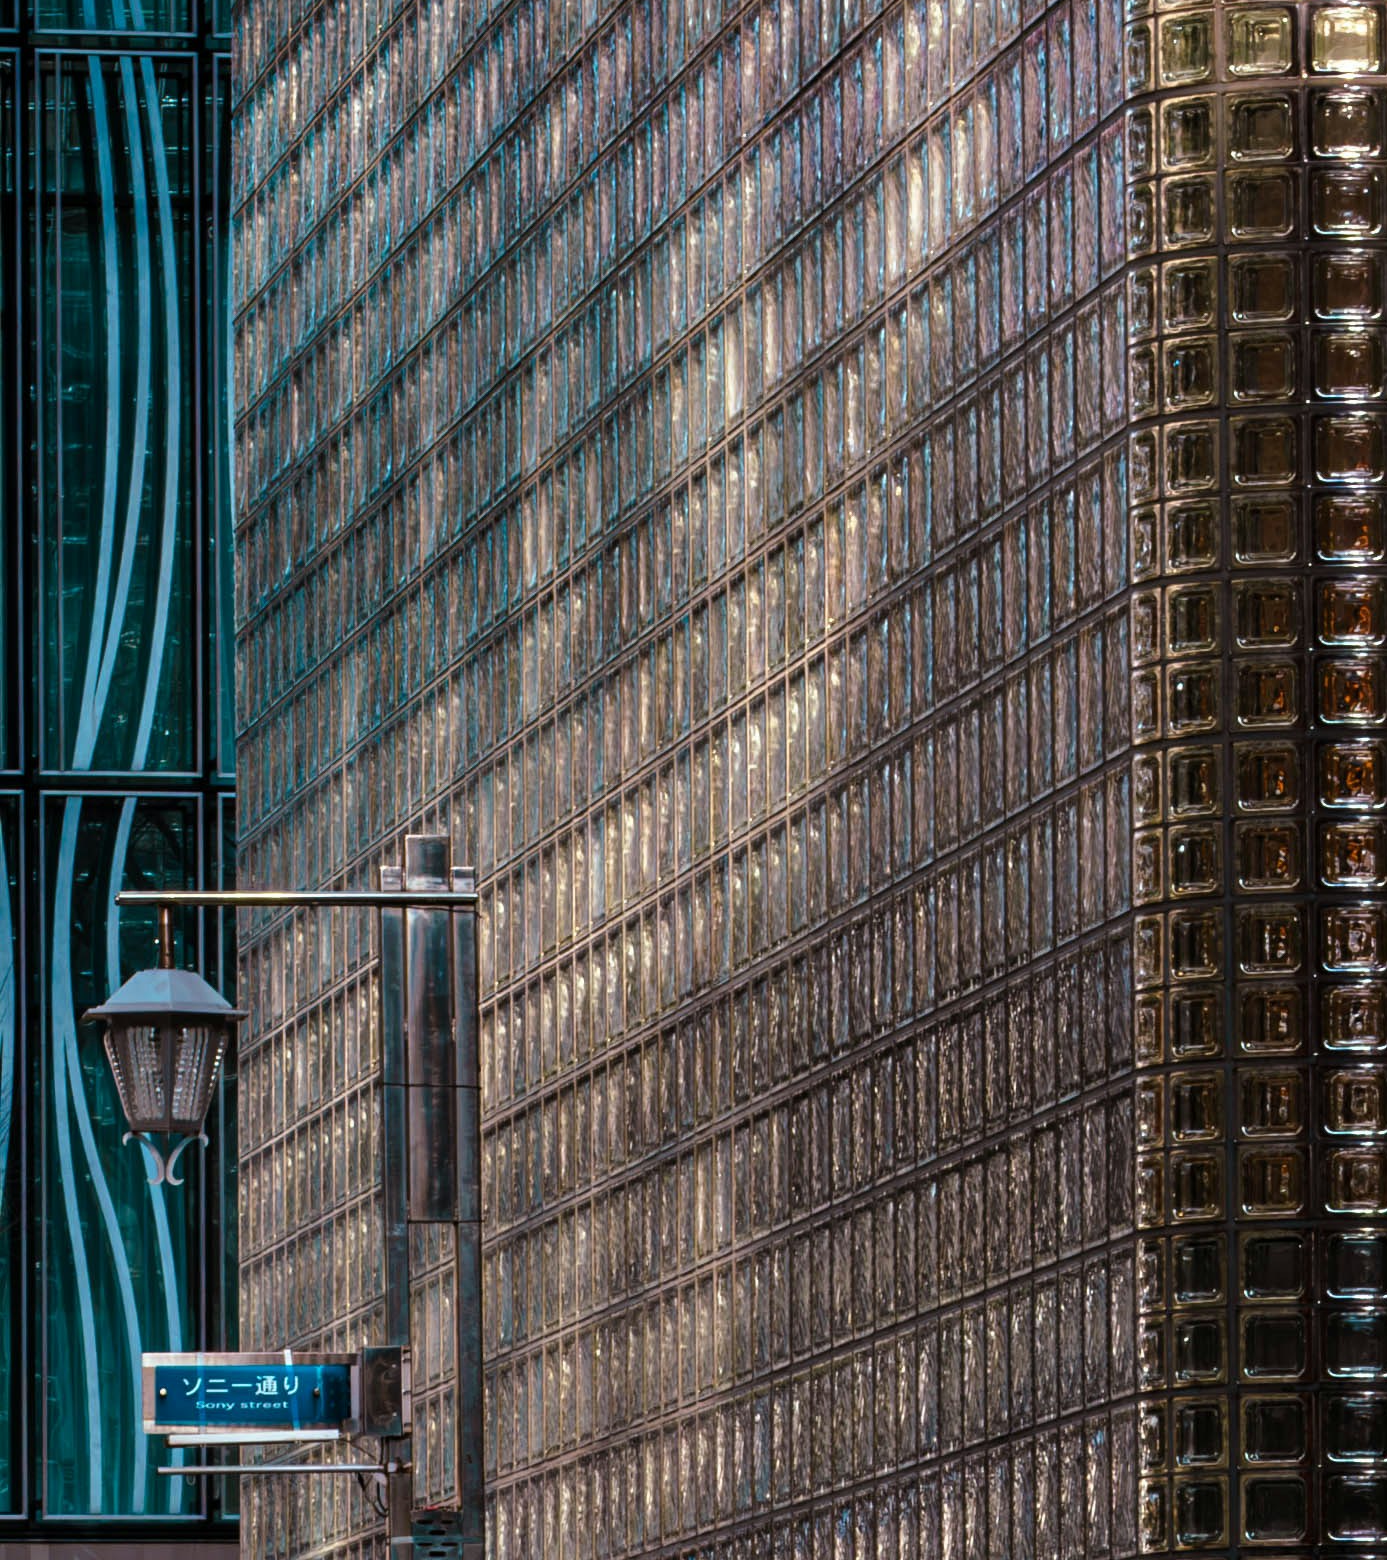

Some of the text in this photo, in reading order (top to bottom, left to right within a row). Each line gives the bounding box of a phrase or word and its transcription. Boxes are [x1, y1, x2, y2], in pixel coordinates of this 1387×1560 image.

[183, 1375, 299, 1396] ソニー通り
[196, 1400, 289, 1410] Sony street
